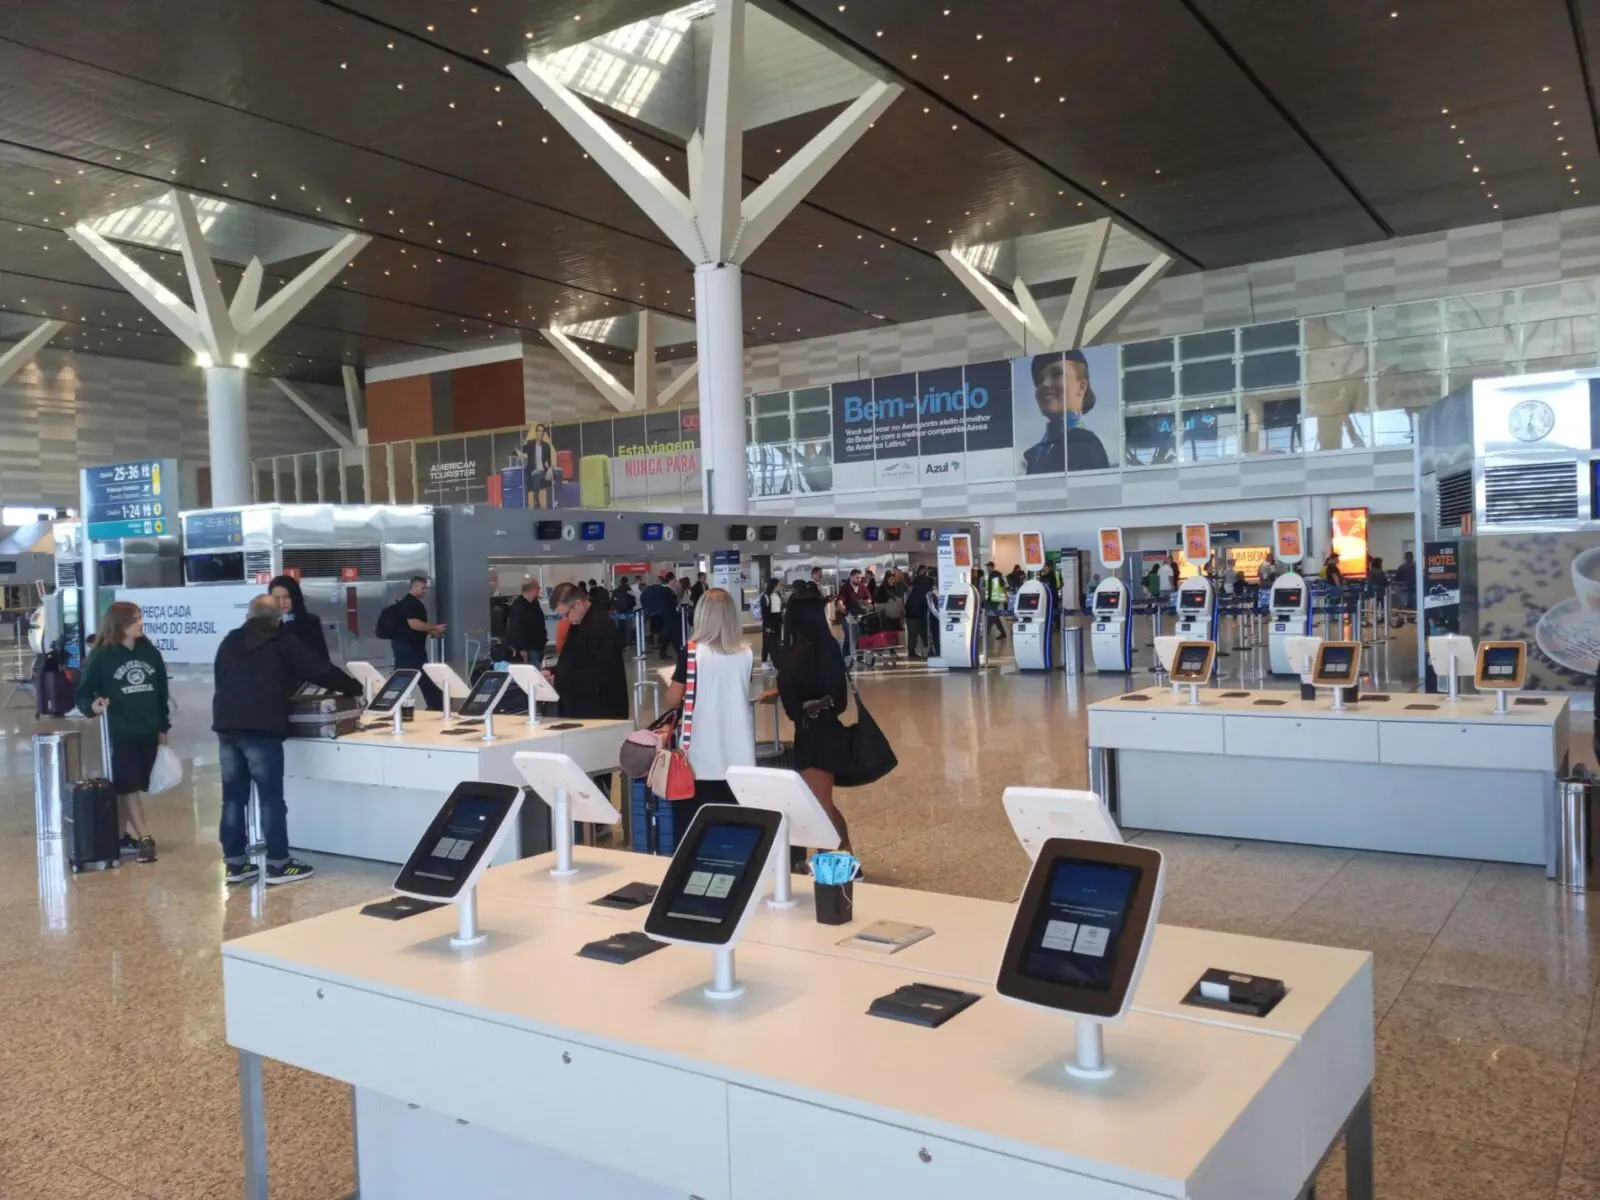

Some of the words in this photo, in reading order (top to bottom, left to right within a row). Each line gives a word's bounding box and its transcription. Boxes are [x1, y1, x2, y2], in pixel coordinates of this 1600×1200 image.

[845, 382, 988, 424] Bem-vindo
[846, 427, 861, 436] Você
[863, 426, 873, 434] vai
[875, 424, 890, 433] voar
[902, 420, 938, 430] Aeroporto
[939, 417, 958, 426] eleito
[967, 414, 991, 424] melhor
[846, 436, 854, 444] do
[881, 433, 895, 441] com
[902, 429, 926, 439] melhor
[927, 424, 965, 436] companhia
[967, 422, 988, 432] Aérea
[618, 445, 645, 458] Esta
[646, 440, 695, 456] viagem
[846, 444, 854, 452] da
[856, 440, 883, 451] América
[114, 465, 139, 481] 25-36
[430, 460, 476, 472] AMERICAN
[625, 456, 664, 479] NUNCA
[666, 454, 697, 473] PARA
[925, 461, 949, 474] Azul
[430, 469, 476, 480] TOURISTER
[122, 504, 141, 518] 1-24
[1428, 554, 1457, 566] HOTEL
[167, 604, 192, 618] CADA
[170, 621, 184, 635] DO
[185, 620, 218, 635] BRASIL
